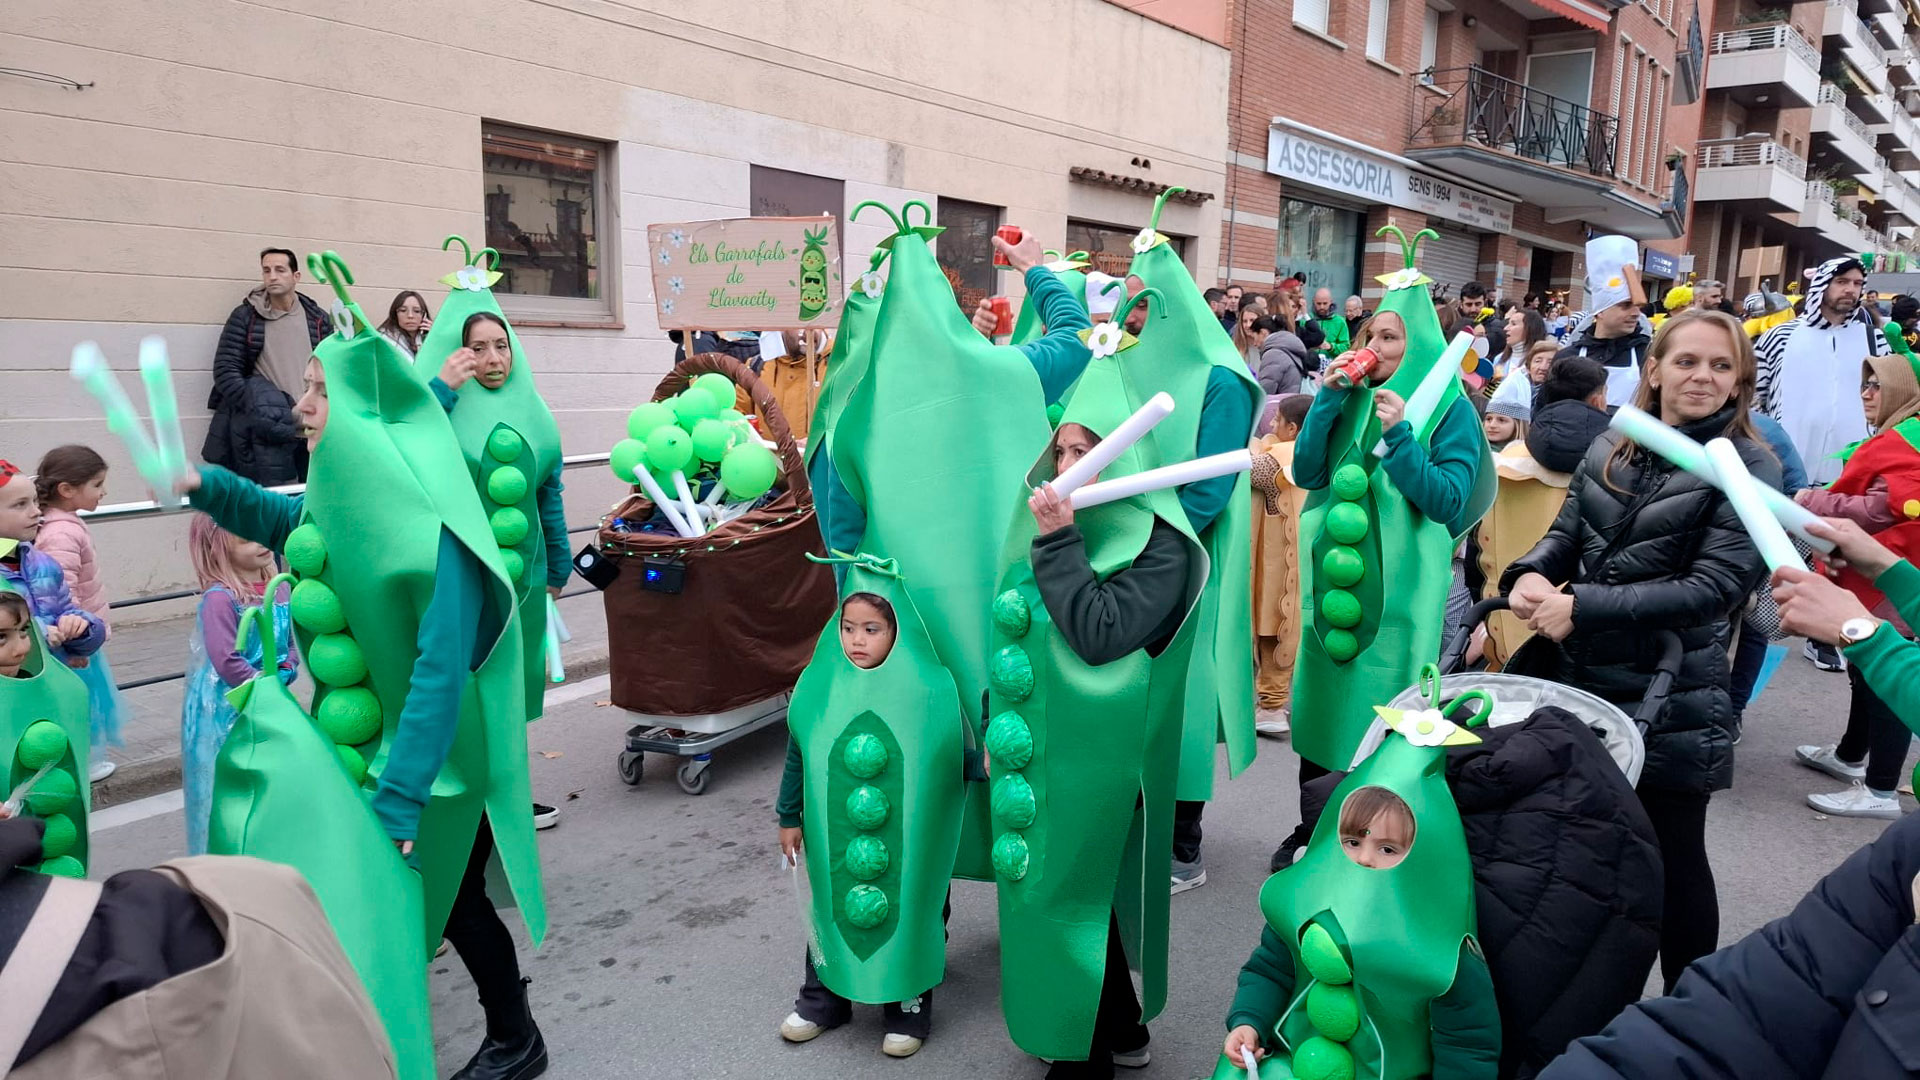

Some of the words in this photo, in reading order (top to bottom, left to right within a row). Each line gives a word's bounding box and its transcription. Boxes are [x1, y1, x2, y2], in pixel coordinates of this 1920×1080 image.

[1278, 137, 1394, 199] ASSESSORIA
[1408, 175, 1431, 197] SENS
[1433, 182, 1452, 203] 1994
[689, 243, 709, 263] Els
[715, 241, 785, 266] Garrofals
[727, 264, 744, 284] de
[709, 288, 777, 311] Llavacity
